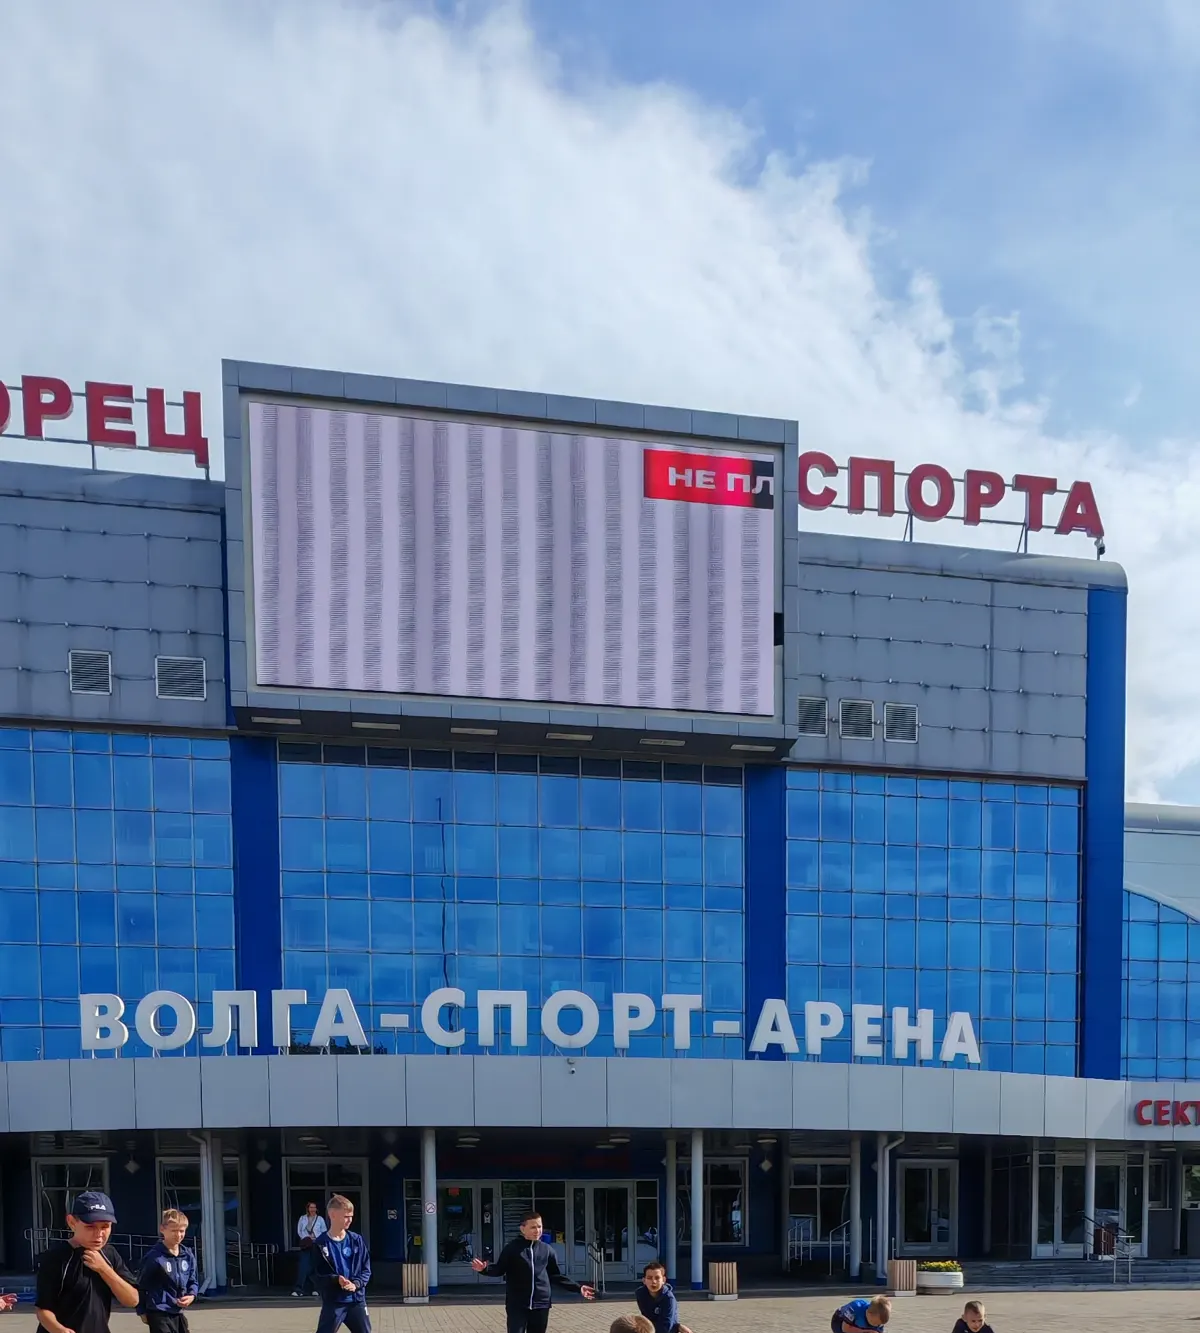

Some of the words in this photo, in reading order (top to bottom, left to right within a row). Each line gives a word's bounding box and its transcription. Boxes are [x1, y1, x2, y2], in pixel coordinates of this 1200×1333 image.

[0, 374, 210, 469] РЕЦ
[668, 466, 716, 490] НЕ
[798, 450, 1105, 538] СПОРТА
[80, 987, 981, 1064] ВОЛГА-СПОРТ-АРЕНА
